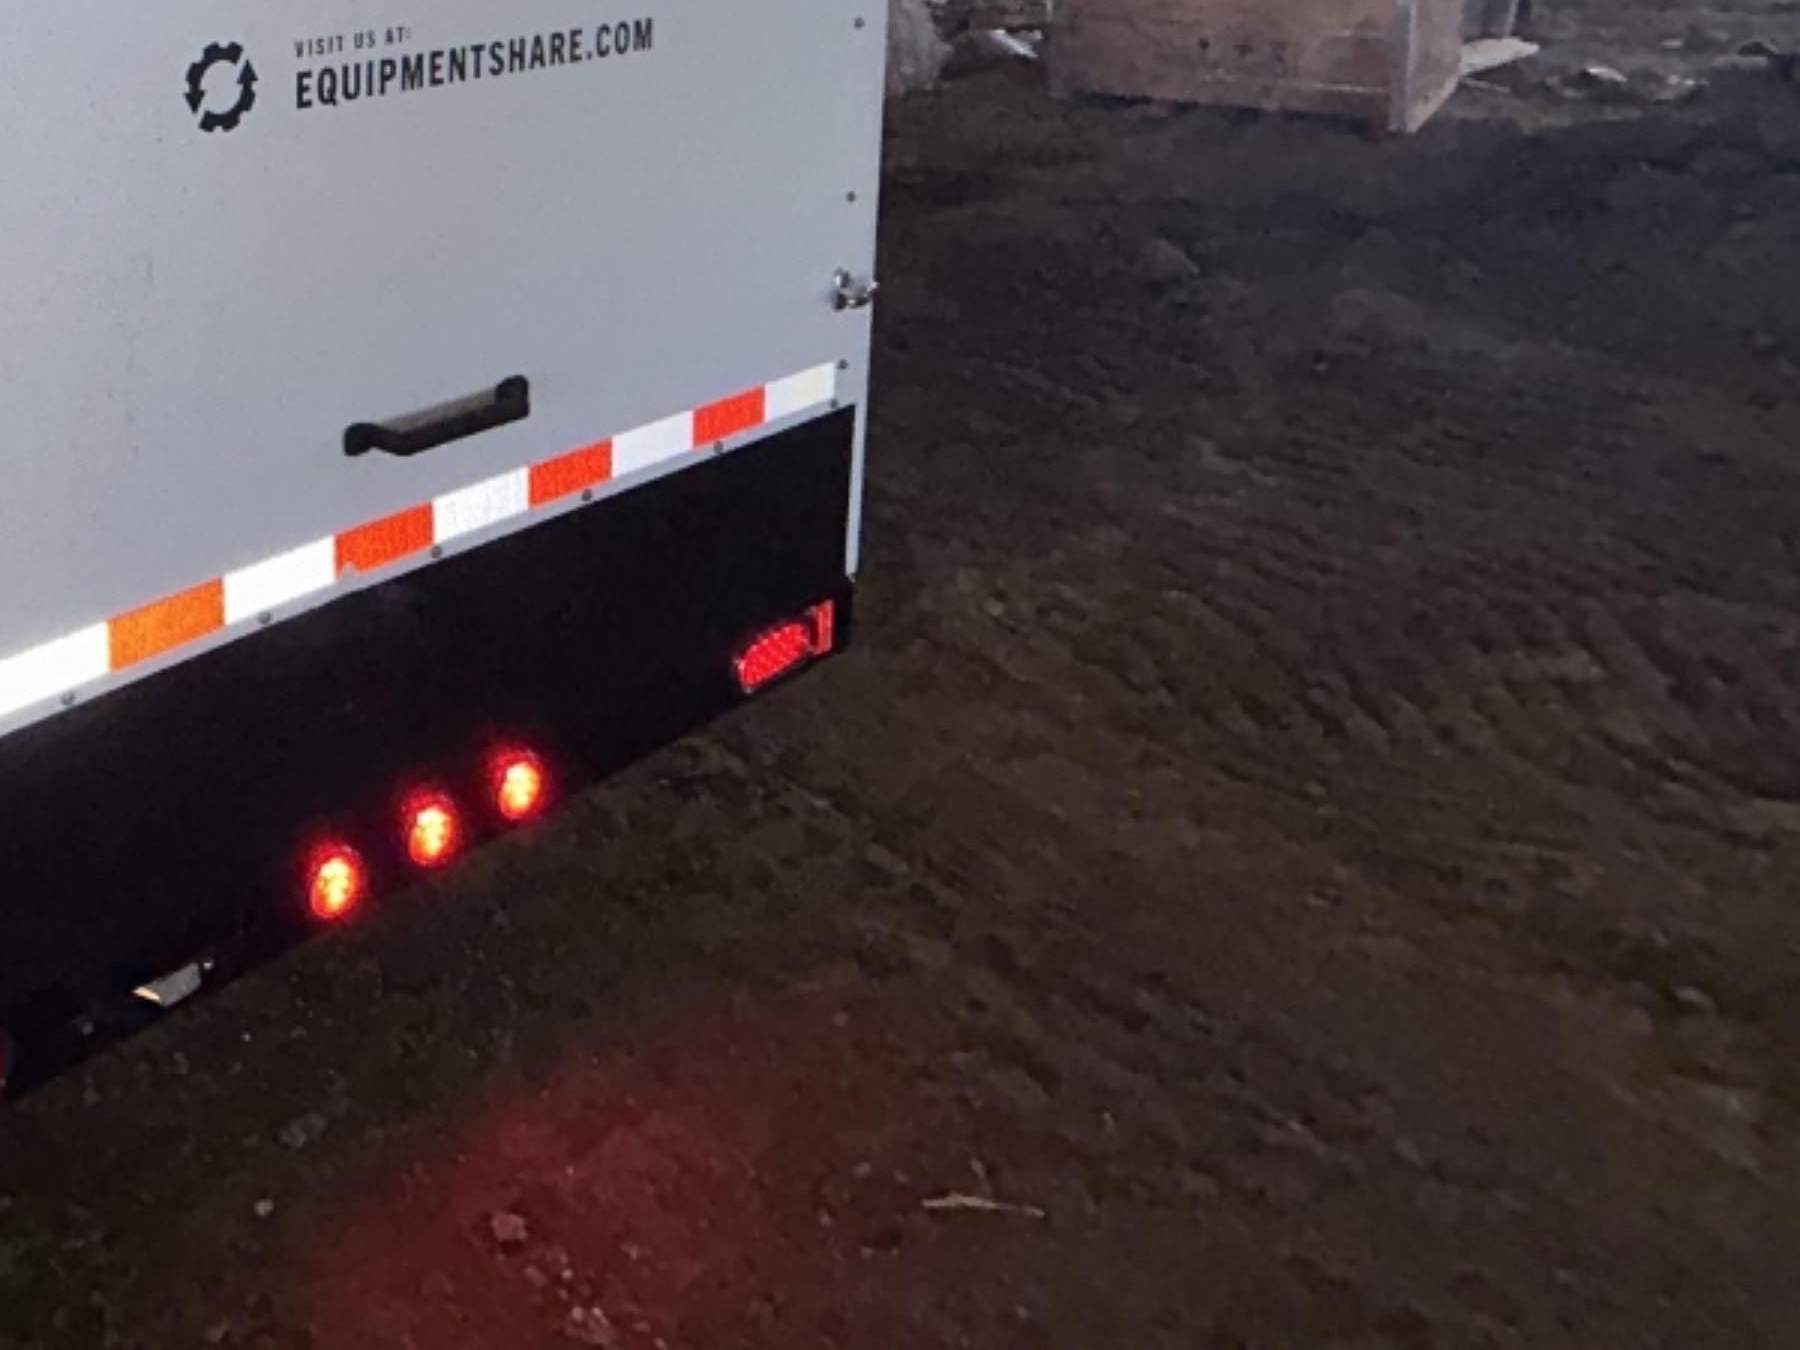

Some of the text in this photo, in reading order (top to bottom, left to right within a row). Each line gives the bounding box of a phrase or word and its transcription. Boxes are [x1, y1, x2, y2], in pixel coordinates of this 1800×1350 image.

[294, 35, 345, 58] VISIT
[353, 30, 377, 50] US
[295, 17, 654, 110] EQUIPMENTSHARE.COM
